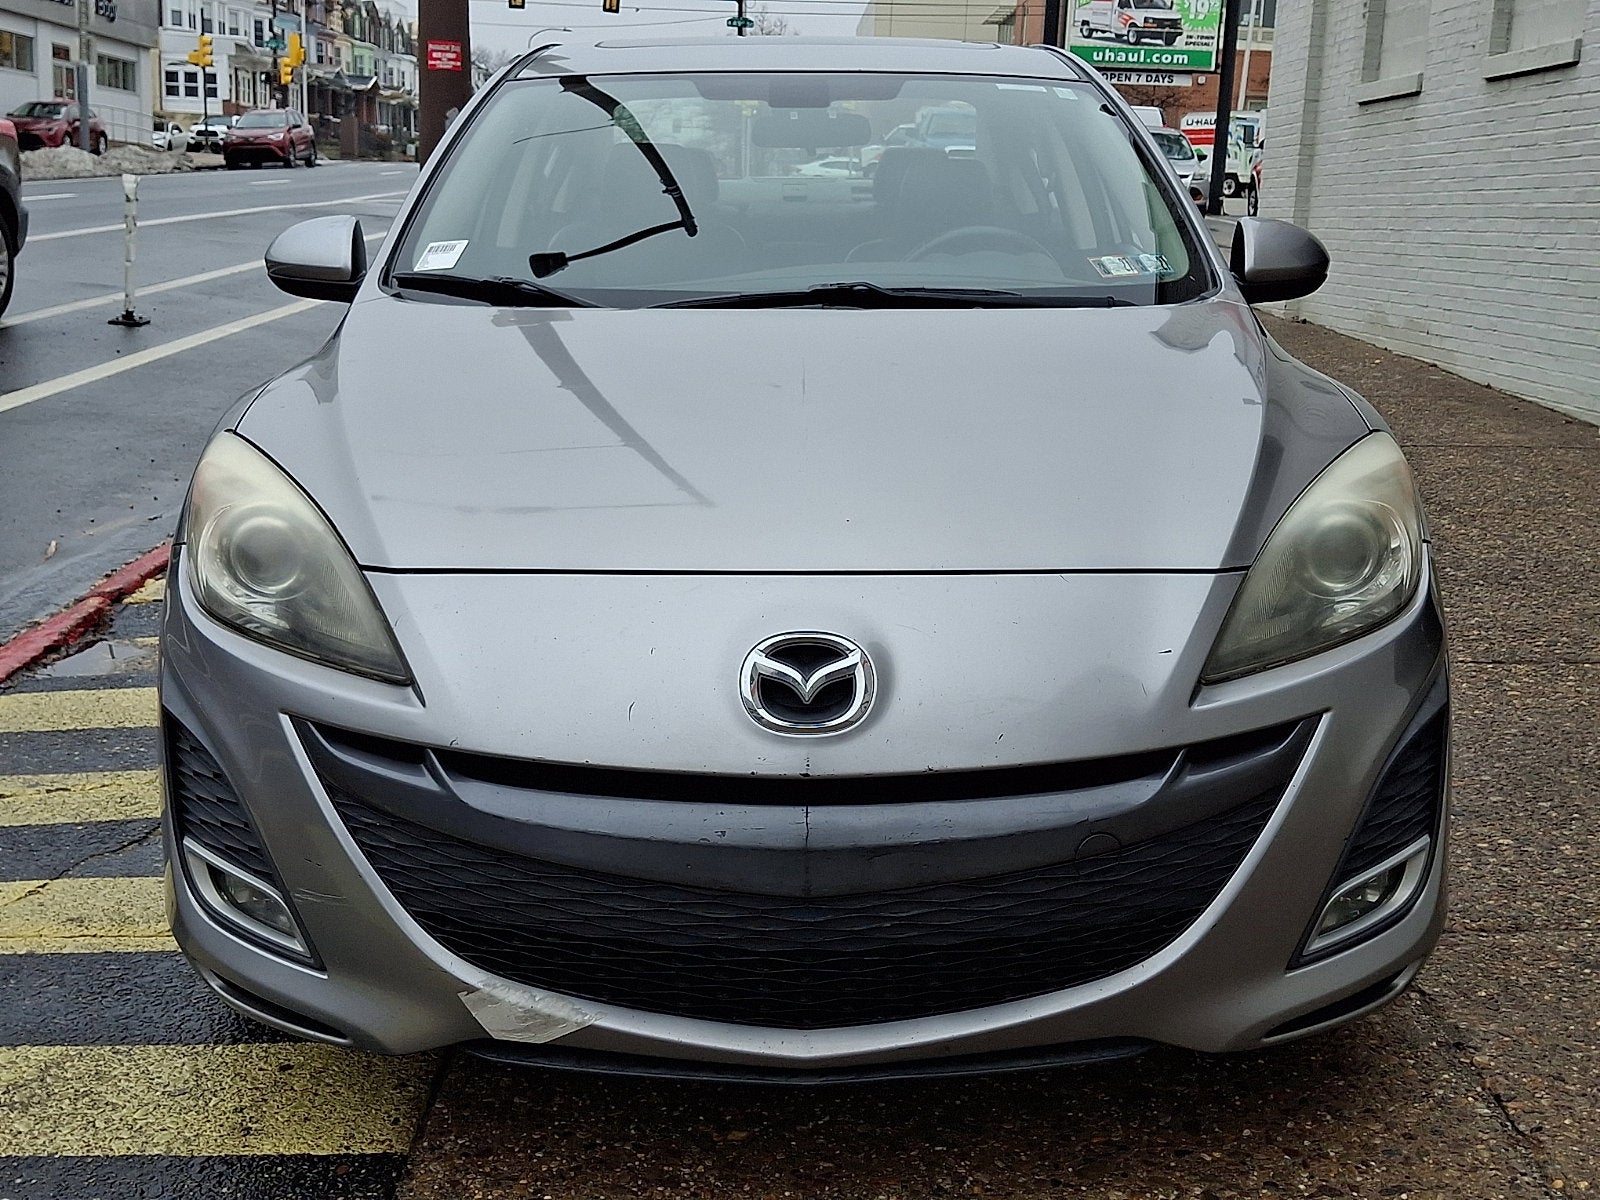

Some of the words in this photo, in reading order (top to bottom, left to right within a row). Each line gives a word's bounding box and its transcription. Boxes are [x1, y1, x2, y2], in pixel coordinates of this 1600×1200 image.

[1092, 48, 1189, 65] uhaul.com
[1101, 72, 1132, 83] OPEN
[1135, 73, 1142, 83] 7
[1145, 74, 1174, 84] DAYS
[1186, 118, 1217, 126] U-HAU
